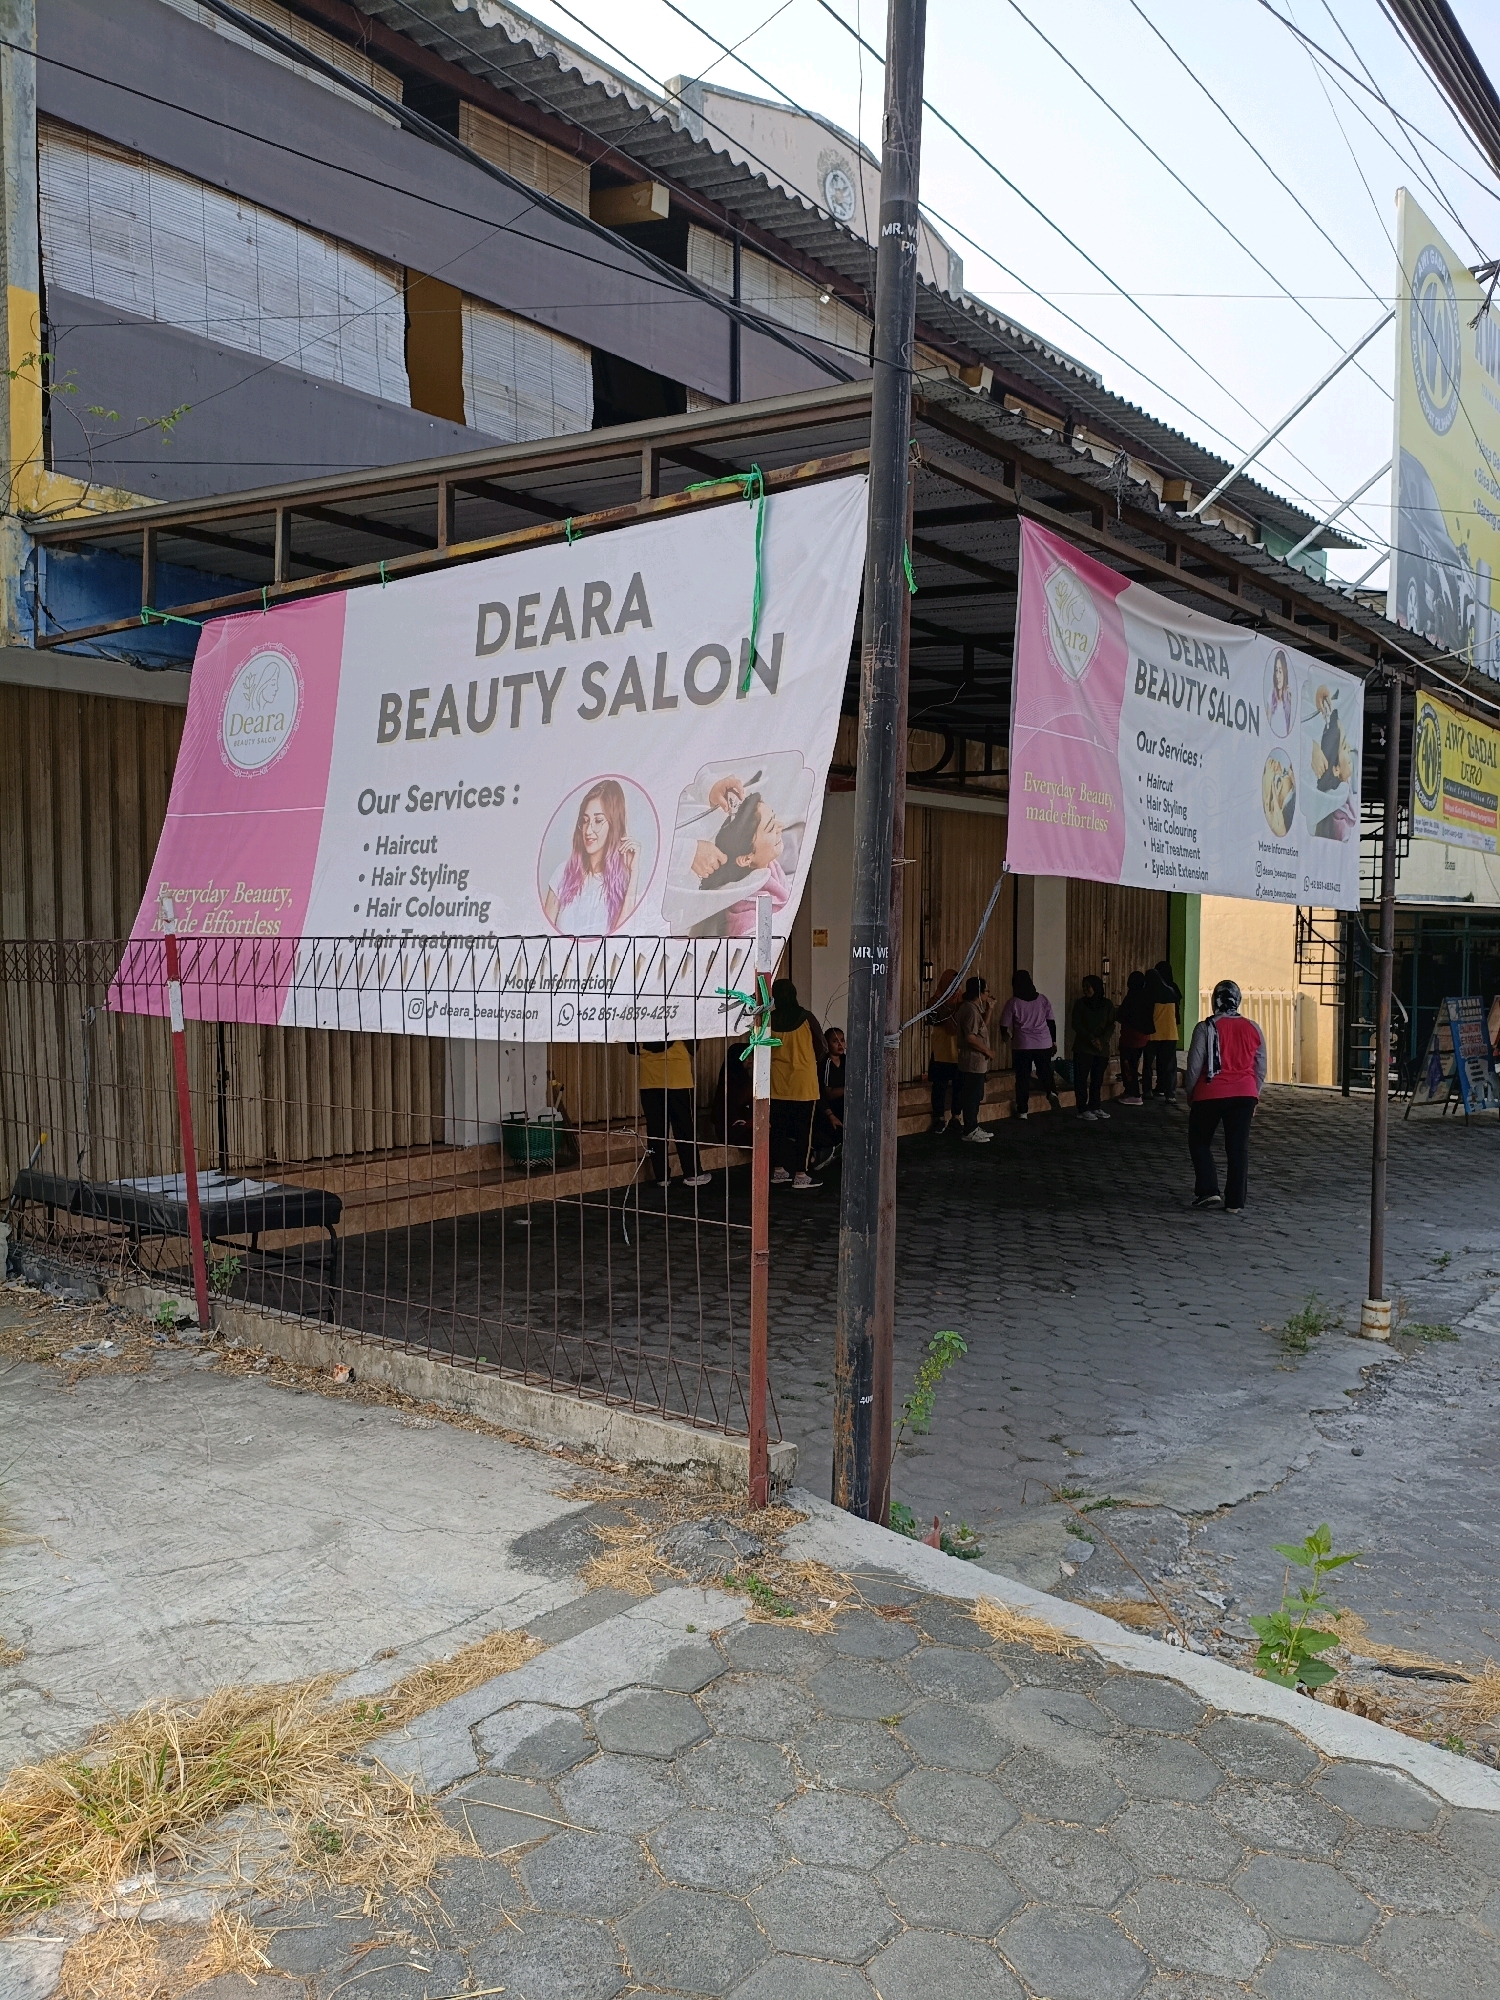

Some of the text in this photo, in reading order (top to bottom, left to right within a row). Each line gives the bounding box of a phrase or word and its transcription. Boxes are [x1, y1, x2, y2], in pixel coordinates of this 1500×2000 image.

[882, 223, 904, 236] MR.
[475, 571, 653, 657] DEARA
[1163, 628, 1230, 680] DEARA
[377, 632, 785, 744] BEAUTY SALON
[1134, 658, 1260, 736] BEAUTY SALON
[229, 712, 285, 737] Deara
[233, 738, 255, 747] BEAUTY
[1136, 731, 1157, 755] Our
[1158, 737, 1198, 767] Services
[1467, 731, 1497, 769] GADAI
[1023, 771, 1116, 813] Everyday Beauty,
[1146, 772, 1173, 793] Haircut
[357, 788, 400, 815] Our
[405, 780, 506, 813] Services
[1146, 795, 1187, 820] Hair Styling
[1026, 800, 1108, 832] made effortless
[1148, 816, 1197, 843] Hair Colouring
[376, 835, 438, 855] Haircut
[1150, 838, 1201, 859] Hair Treatment
[1258, 840, 1299, 857] More Information
[371, 863, 469, 892] Hair Styling
[1152, 859, 1209, 881] Eyelash Extension
[154, 879, 293, 912] Everyday Beauty,
[199, 909, 282, 935] Effortless
[366, 896, 491, 923] Hair Colouring
[360, 928, 499, 949] Hair Treatment
[852, 947, 873, 959] MR.
[873, 963, 888, 975] PO
[504, 974, 613, 991] More Information
